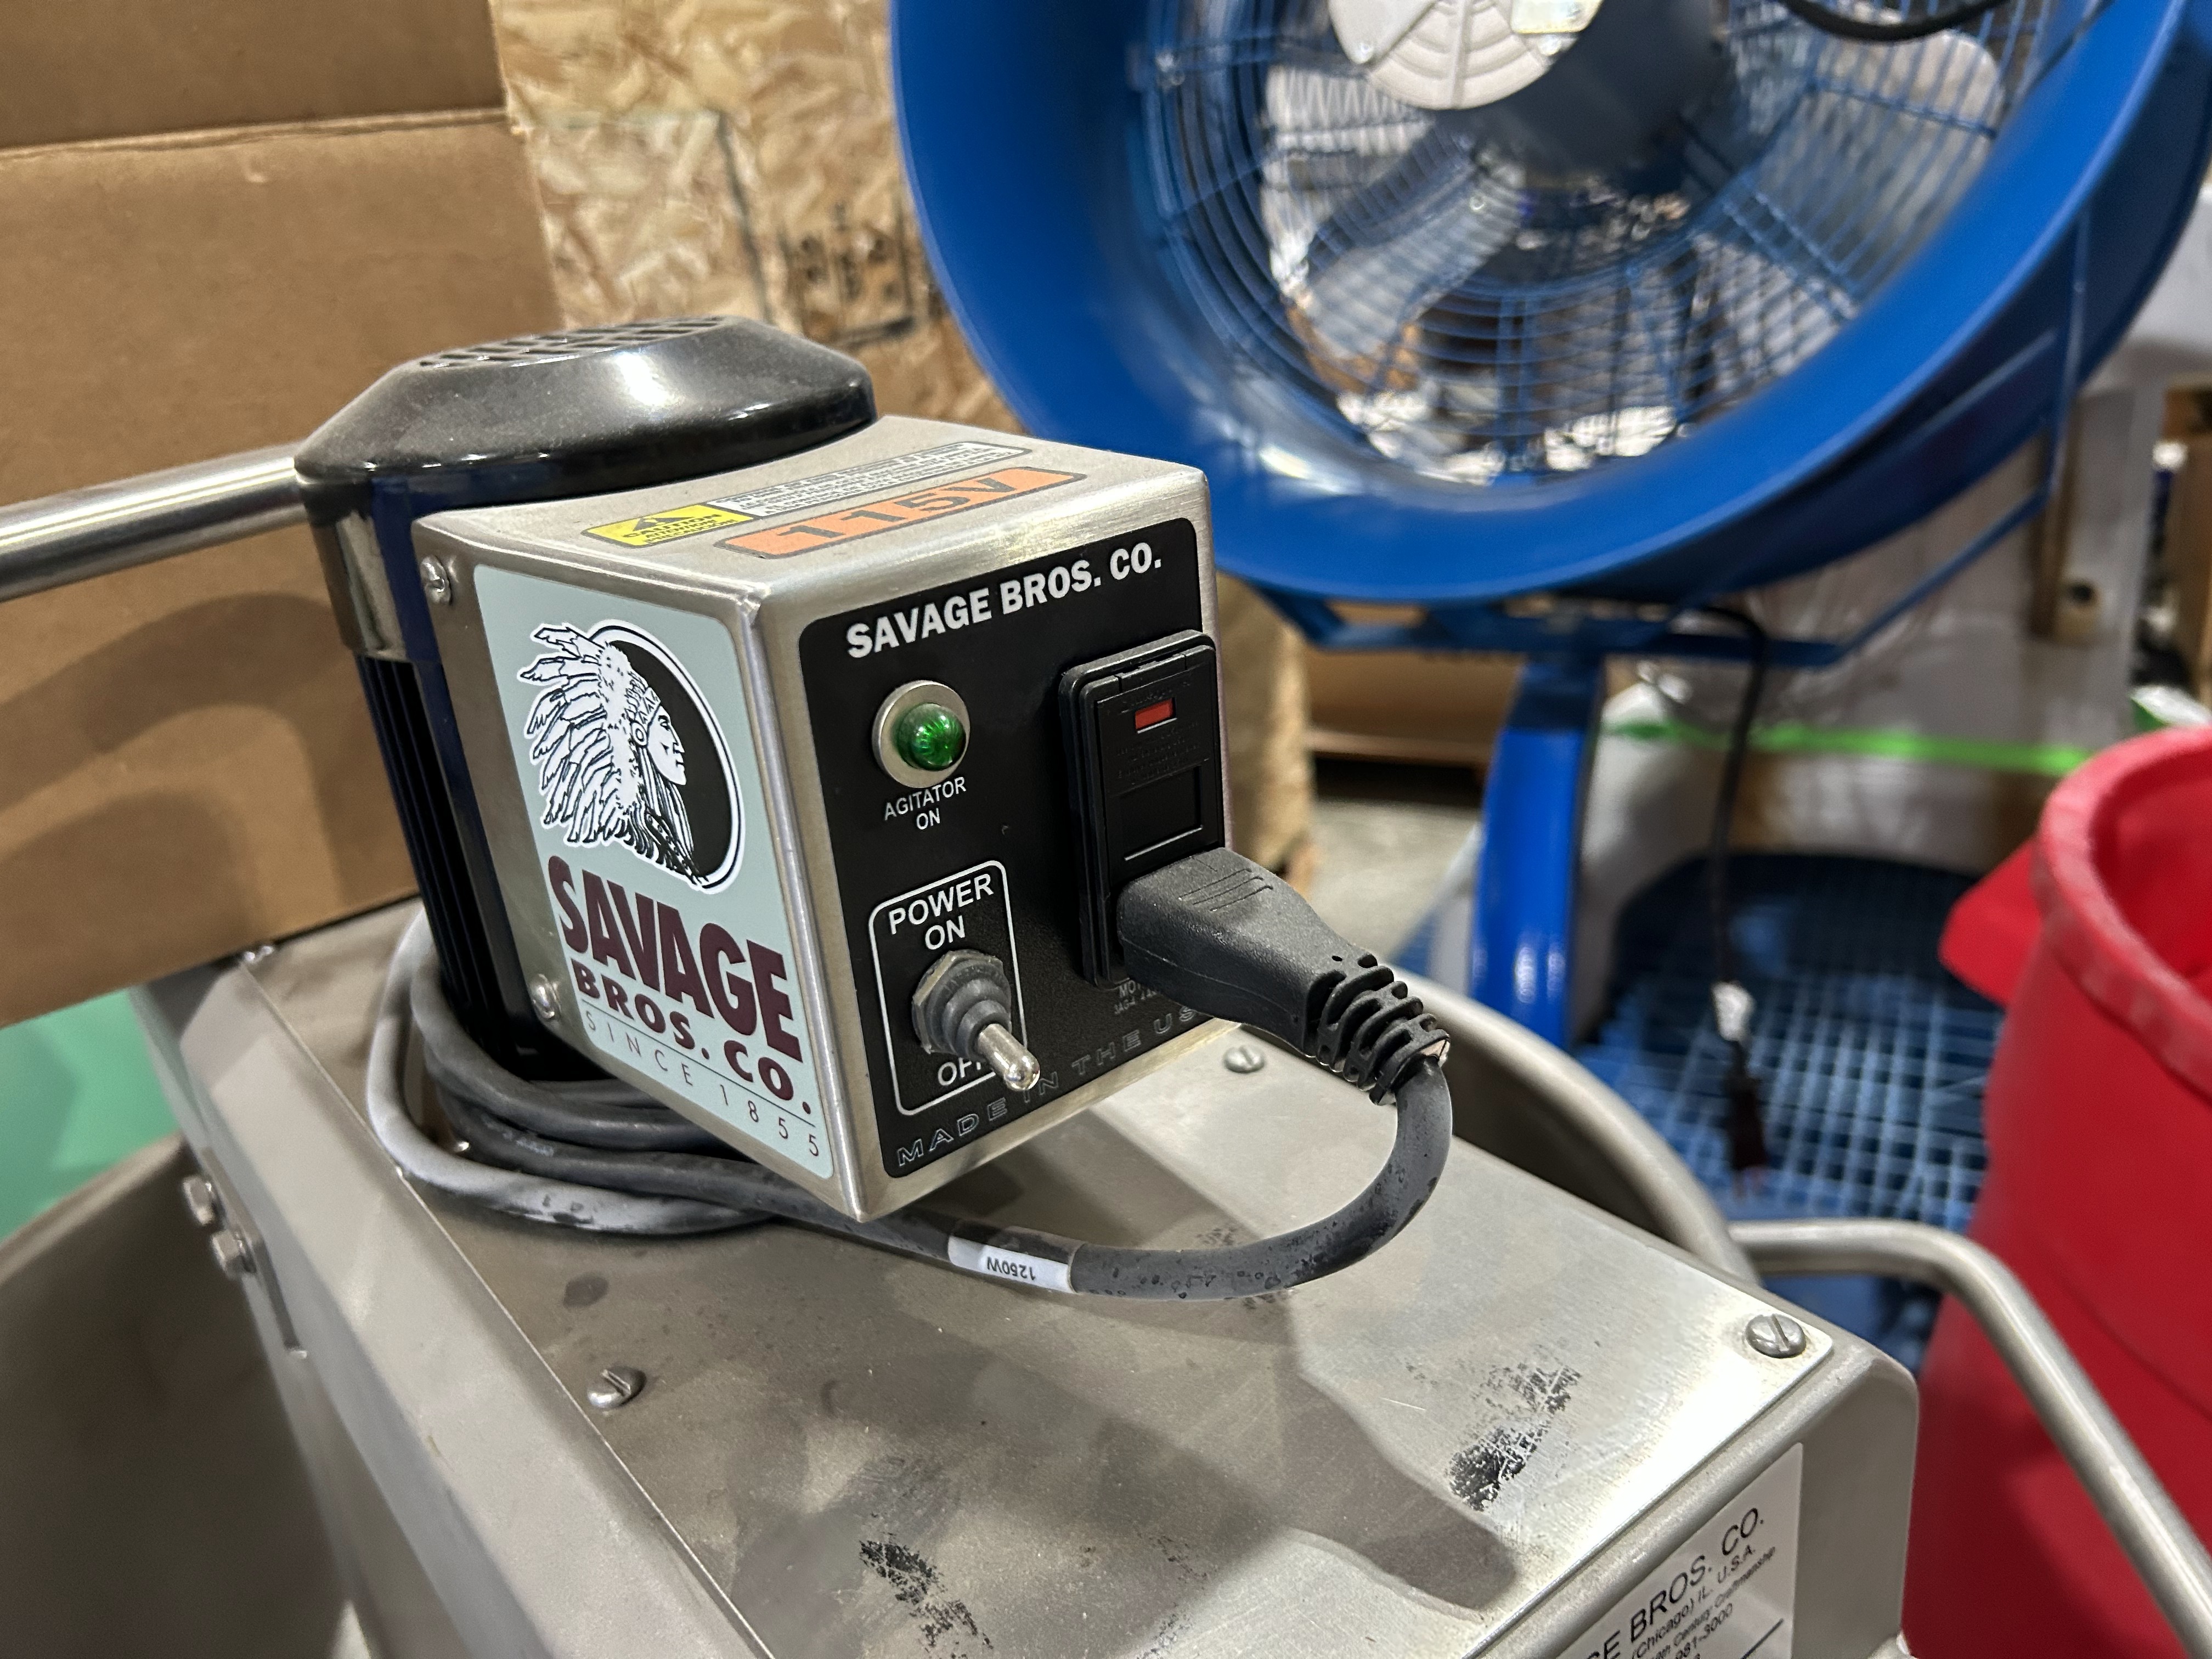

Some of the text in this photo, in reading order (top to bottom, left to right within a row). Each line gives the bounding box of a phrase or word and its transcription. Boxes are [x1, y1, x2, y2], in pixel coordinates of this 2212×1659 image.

[623, 514, 722, 538] CAUTION
[776, 477, 1018, 539] 115V
[847, 541, 1162, 658] SAVAGE BROS. CO.
[884, 776, 967, 821] AGITATOR
[916, 808, 941, 831] ON
[888, 873, 995, 935] POWER
[924, 915, 966, 950] ON
[548, 854, 804, 1064] SAVAGE
[570, 958, 811, 1115] BROS. CO.
[586, 1009, 820, 1157] SINCE 1855
[896, 1005, 1204, 1167] MADE IN THE US
[936, 1057, 982, 1086] OF
[987, 1256, 1036, 1280] 1250W
[1630, 1554, 1712, 1644] BROS.
[1721, 1508, 1764, 1556] CO.
